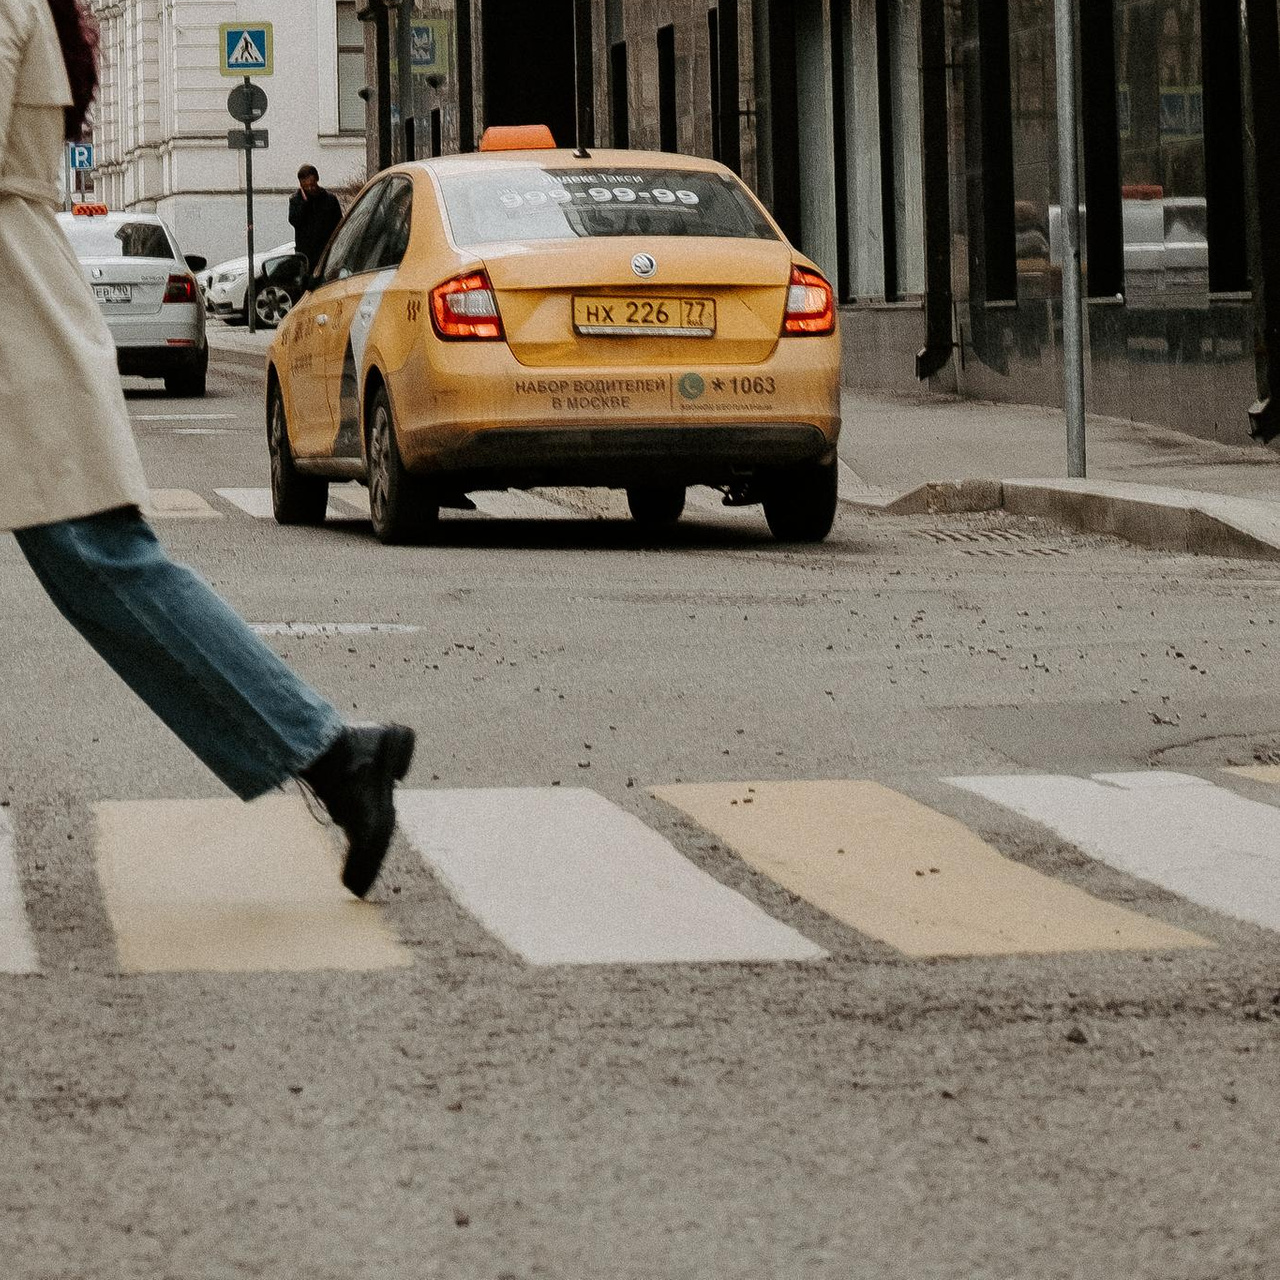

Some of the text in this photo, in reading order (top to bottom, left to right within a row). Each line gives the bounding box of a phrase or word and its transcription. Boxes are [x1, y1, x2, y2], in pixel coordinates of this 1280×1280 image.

[500, 187, 699, 209] 999-99-99
[626, 301, 669, 324] 226
[684, 301, 705, 319] 77
[515, 377, 665, 395] НАБОР ВОДИТЕЛЕЙ
[551, 396, 631, 410] В МОСКВЕ
